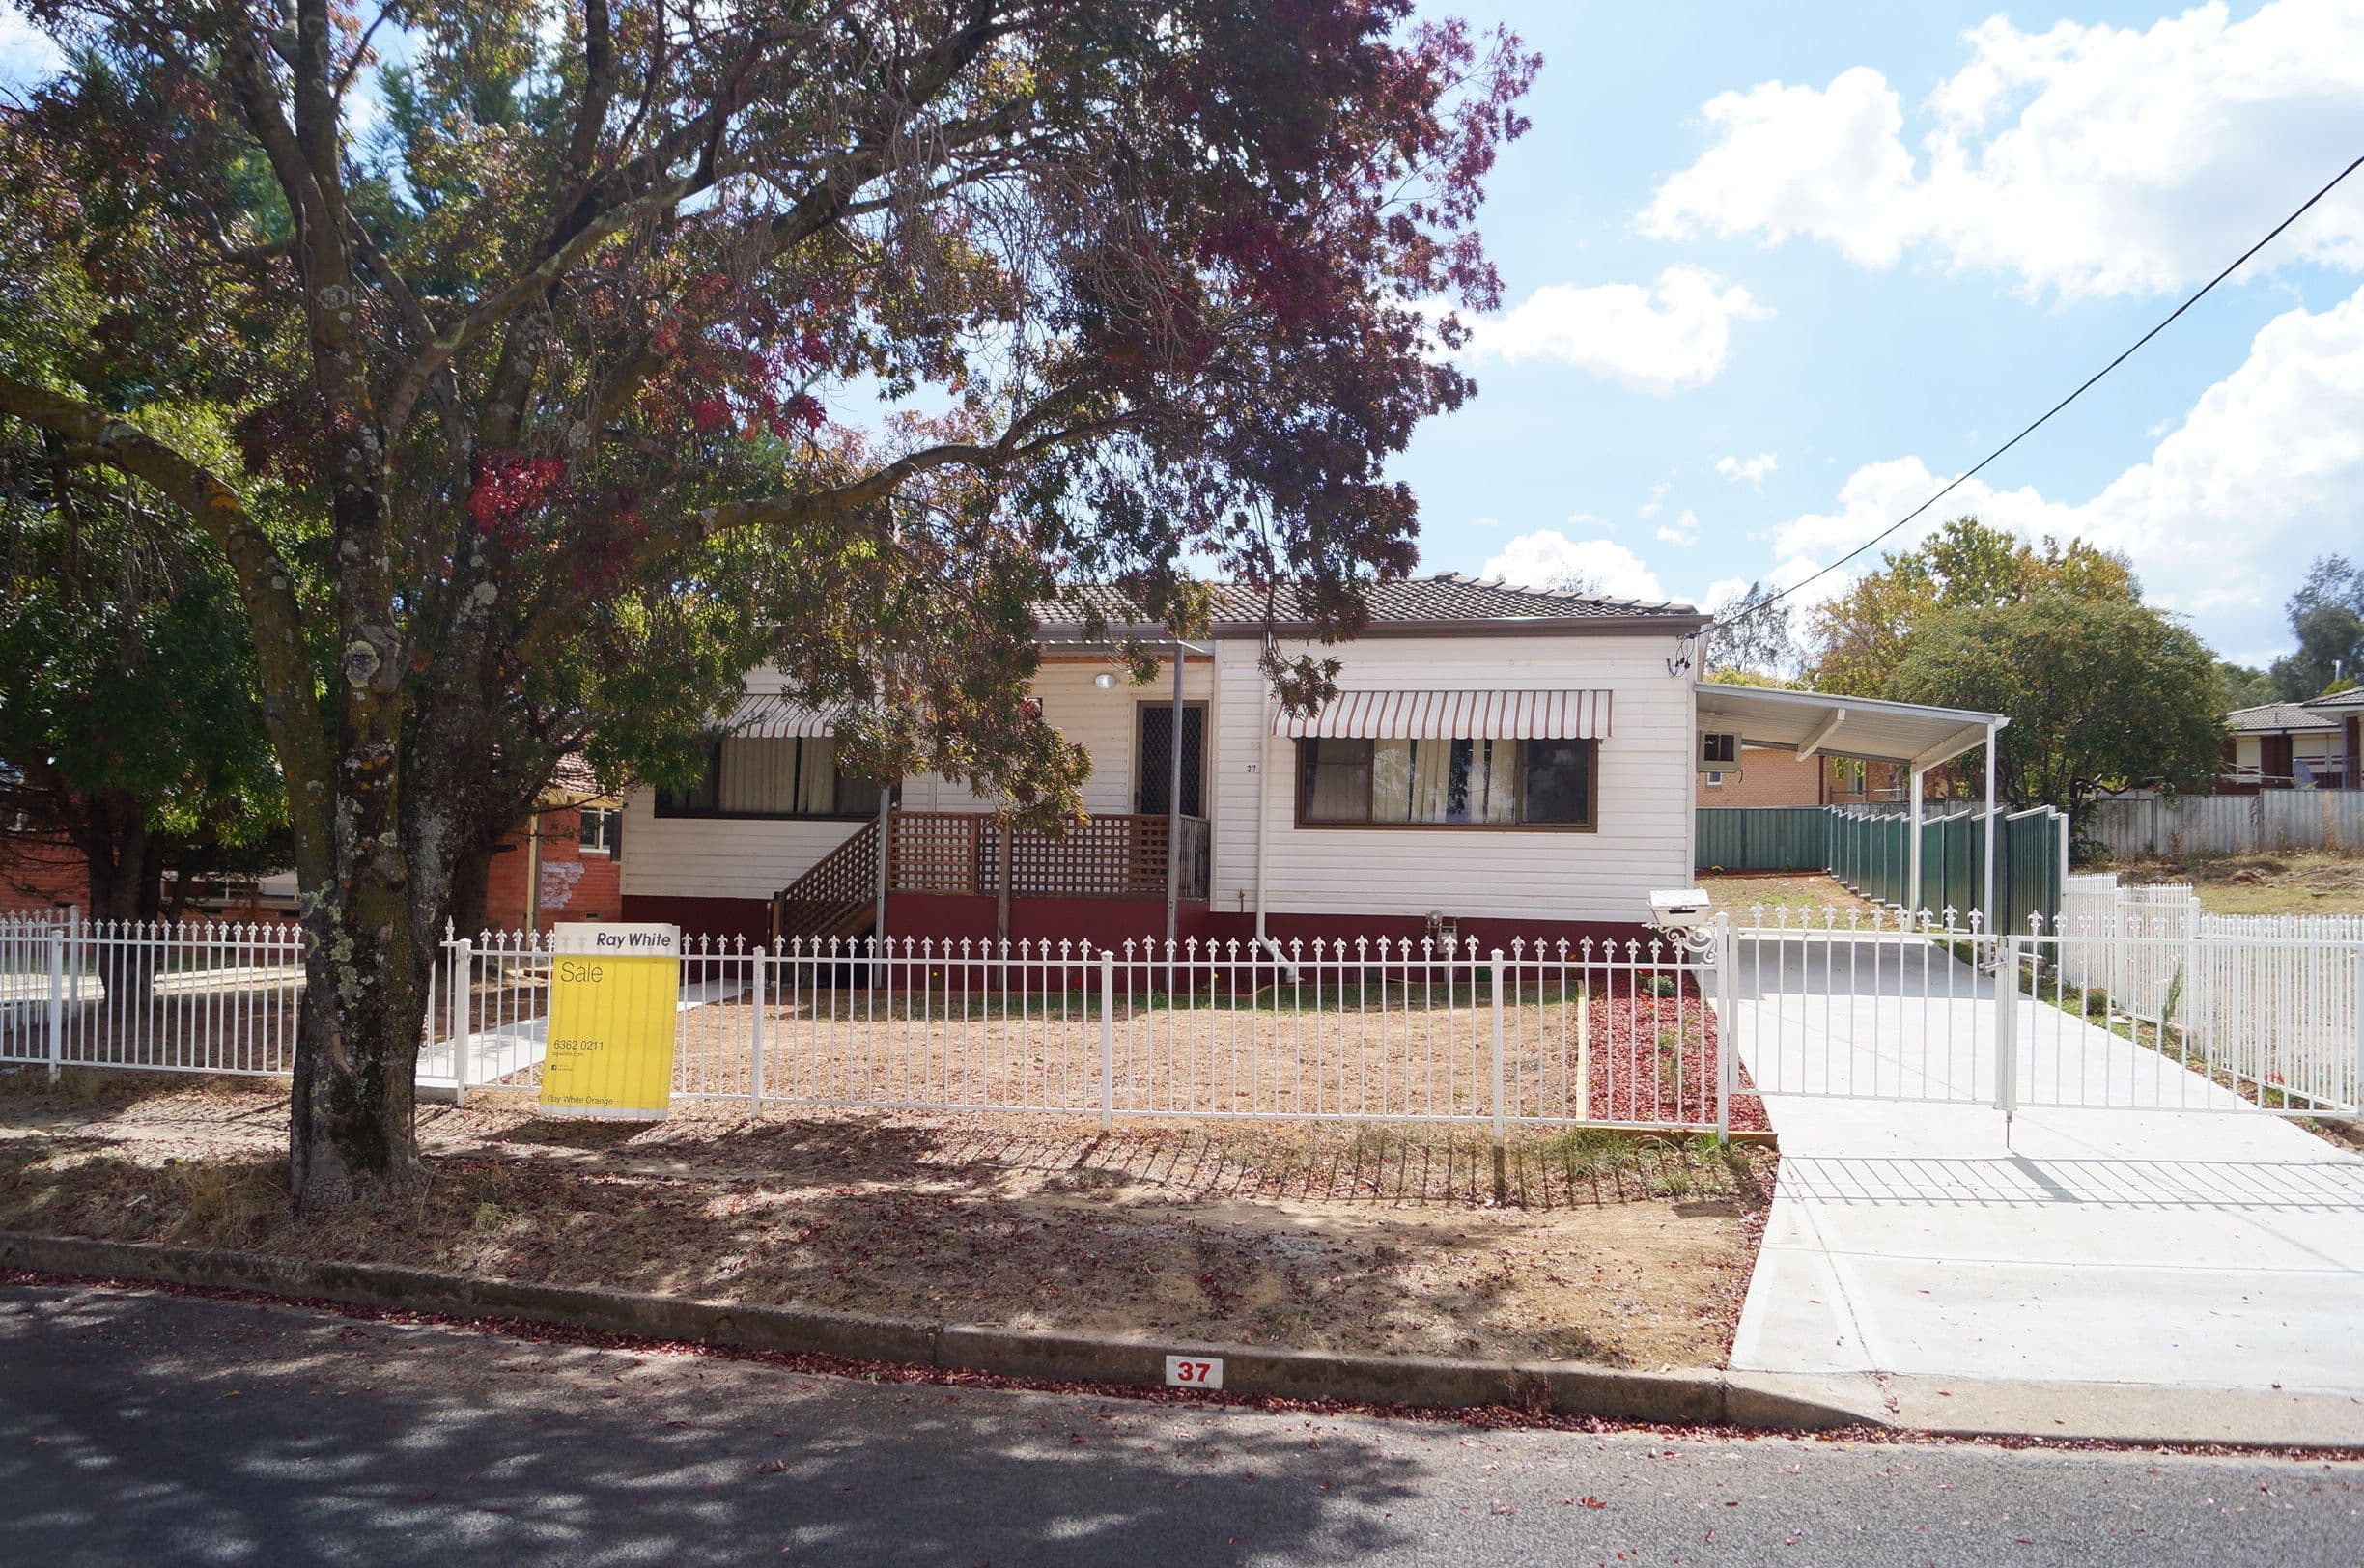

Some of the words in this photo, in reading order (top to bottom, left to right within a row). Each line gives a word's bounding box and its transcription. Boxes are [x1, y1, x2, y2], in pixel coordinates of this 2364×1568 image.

[596, 932, 626, 949] Ray
[629, 933, 671, 946] White
[560, 962, 603, 983] Sale
[553, 1039, 578, 1050] 6362
[580, 1040, 604, 1050] 0211
[547, 1094, 561, 1105] Ray
[585, 1096, 613, 1106] Orange
[1177, 1361, 1211, 1382] 37
